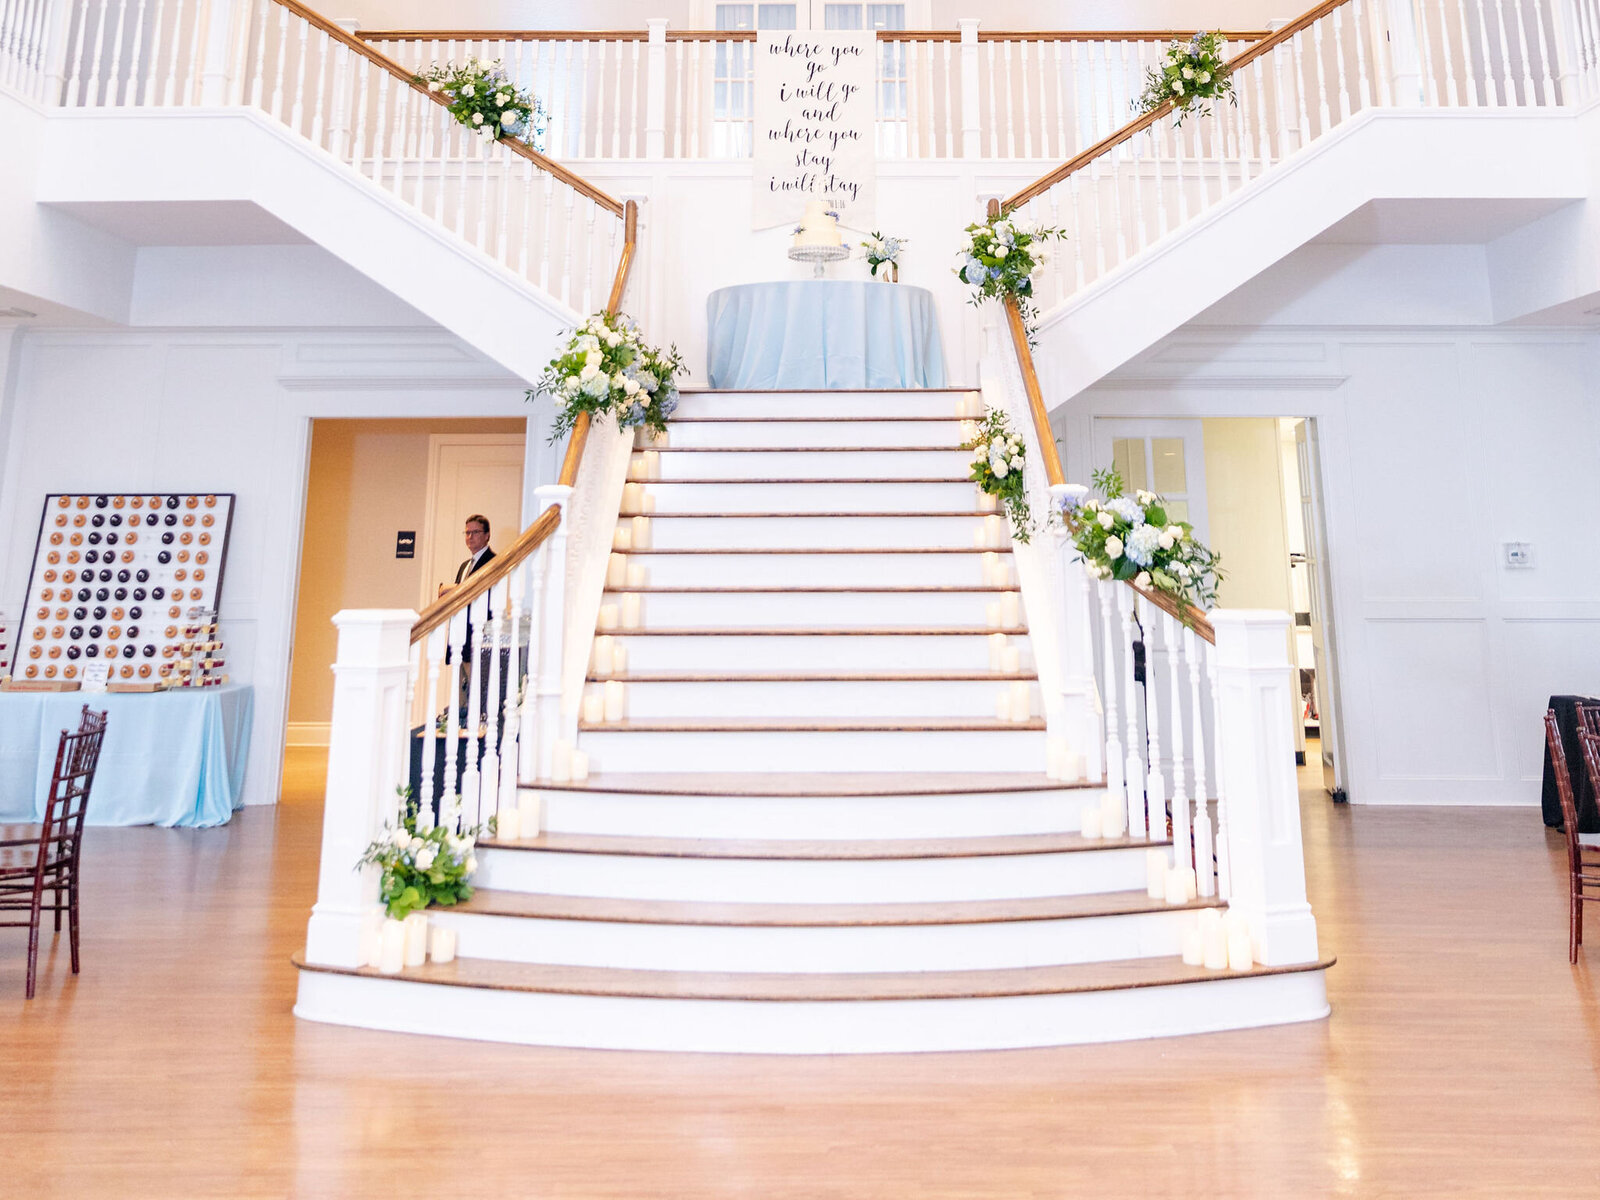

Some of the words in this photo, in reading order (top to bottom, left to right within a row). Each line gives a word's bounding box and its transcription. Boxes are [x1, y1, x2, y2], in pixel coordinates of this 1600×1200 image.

[770, 34, 823, 58] where
[831, 44, 863, 66] you
[806, 61, 826, 82] go
[780, 82, 792, 102] i
[796, 81, 838, 102] will
[841, 83, 859, 103] go
[802, 101, 842, 121] and
[769, 119, 824, 143] where
[829, 128, 862, 151] you
[794, 148, 835, 175] stay
[770, 176, 780, 193] i
[781, 172, 816, 193] will
